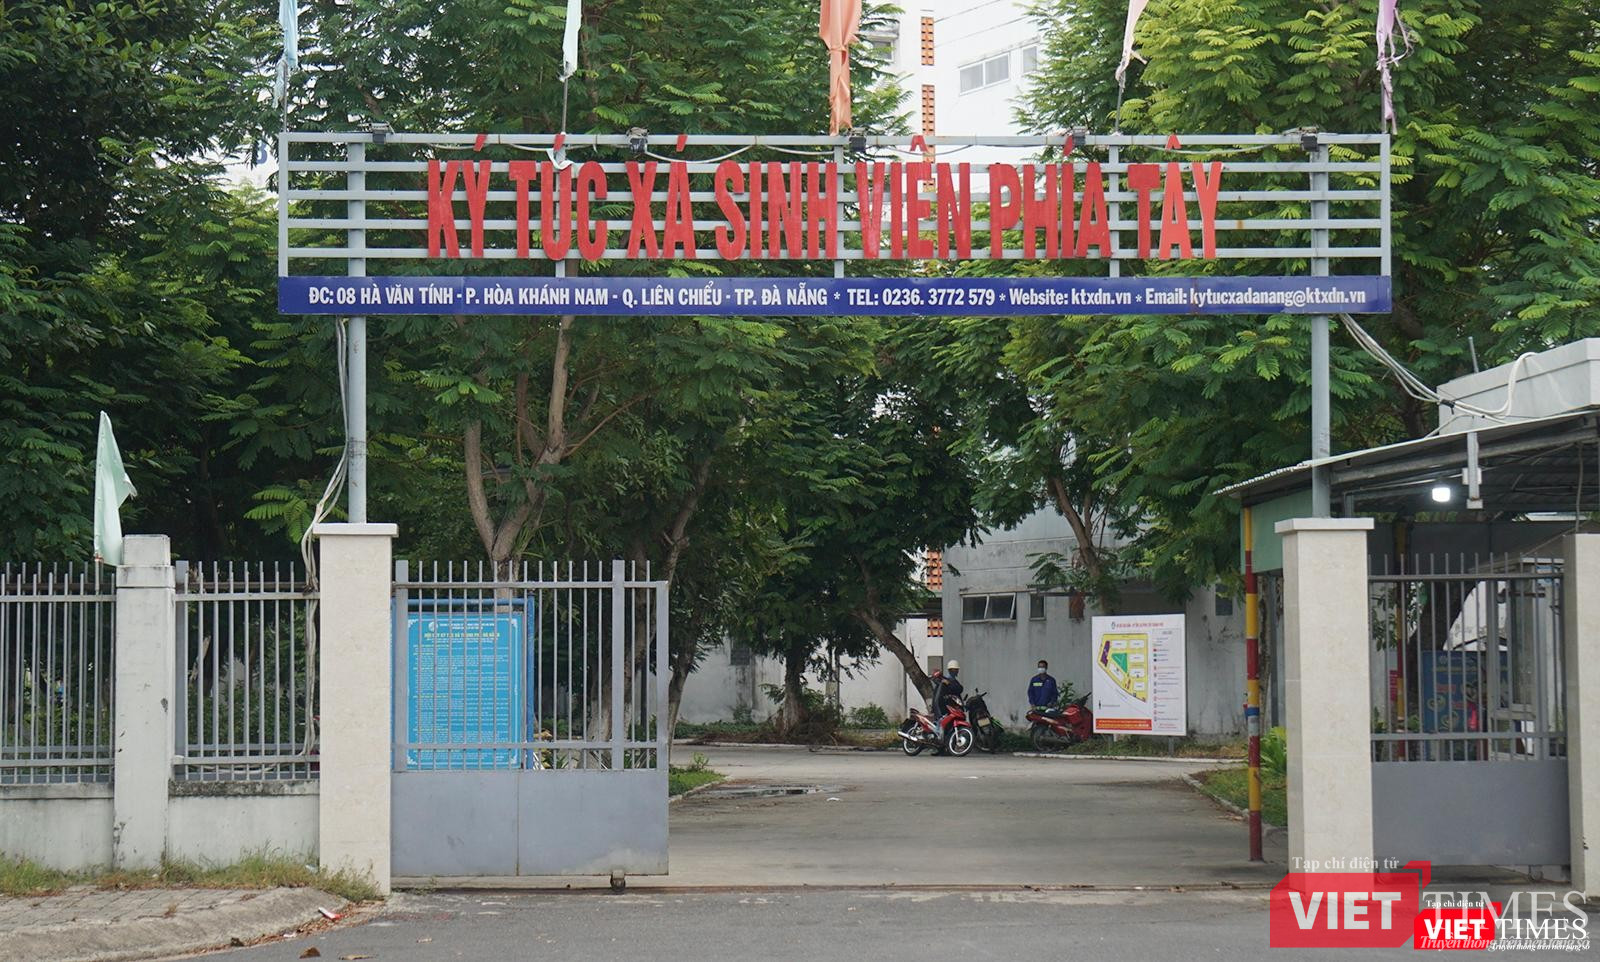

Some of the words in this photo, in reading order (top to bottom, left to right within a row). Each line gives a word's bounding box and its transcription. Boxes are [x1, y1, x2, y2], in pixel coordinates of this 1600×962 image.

[428, 134, 492, 259] KÝ
[509, 134, 607, 261] TÚC
[625, 134, 696, 259] XÁ
[715, 160, 838, 260] SINH
[856, 135, 971, 259] VIÊN
[989, 137, 1111, 259] PHÍA
[1128, 134, 1223, 259] TÂY
[309, 287, 334, 305] ĐC:
[336, 287, 356, 304] 08
[360, 283, 381, 304] HÀ
[386, 283, 414, 304] VĂN
[419, 283, 453, 304] TÍNH
[466, 287, 480, 304] P.
[484, 283, 514, 304] HÒA
[518, 283, 570, 304] KHÁNH
[574, 288, 608, 305] NAM
[622, 288, 638, 308] Q.
[642, 284, 674, 305] LIÊN
[678, 280, 722, 305] CHIỂU
[734, 288, 757, 305] TP.
[761, 285, 782, 305] ĐÀ
[787, 282, 827, 305] NẴNG
[847, 288, 879, 305] TEL:
[882, 288, 924, 305] 0236.
[928, 288, 964, 305] 3772
[968, 288, 995, 305] 579
[1009, 288, 1068, 305] Website:
[1071, 288, 1131, 305] ktxdn.vn
[1145, 287, 1187, 305] Email:
[1190, 286, 1366, 307] kytucxadanang@ktxdn.vn
